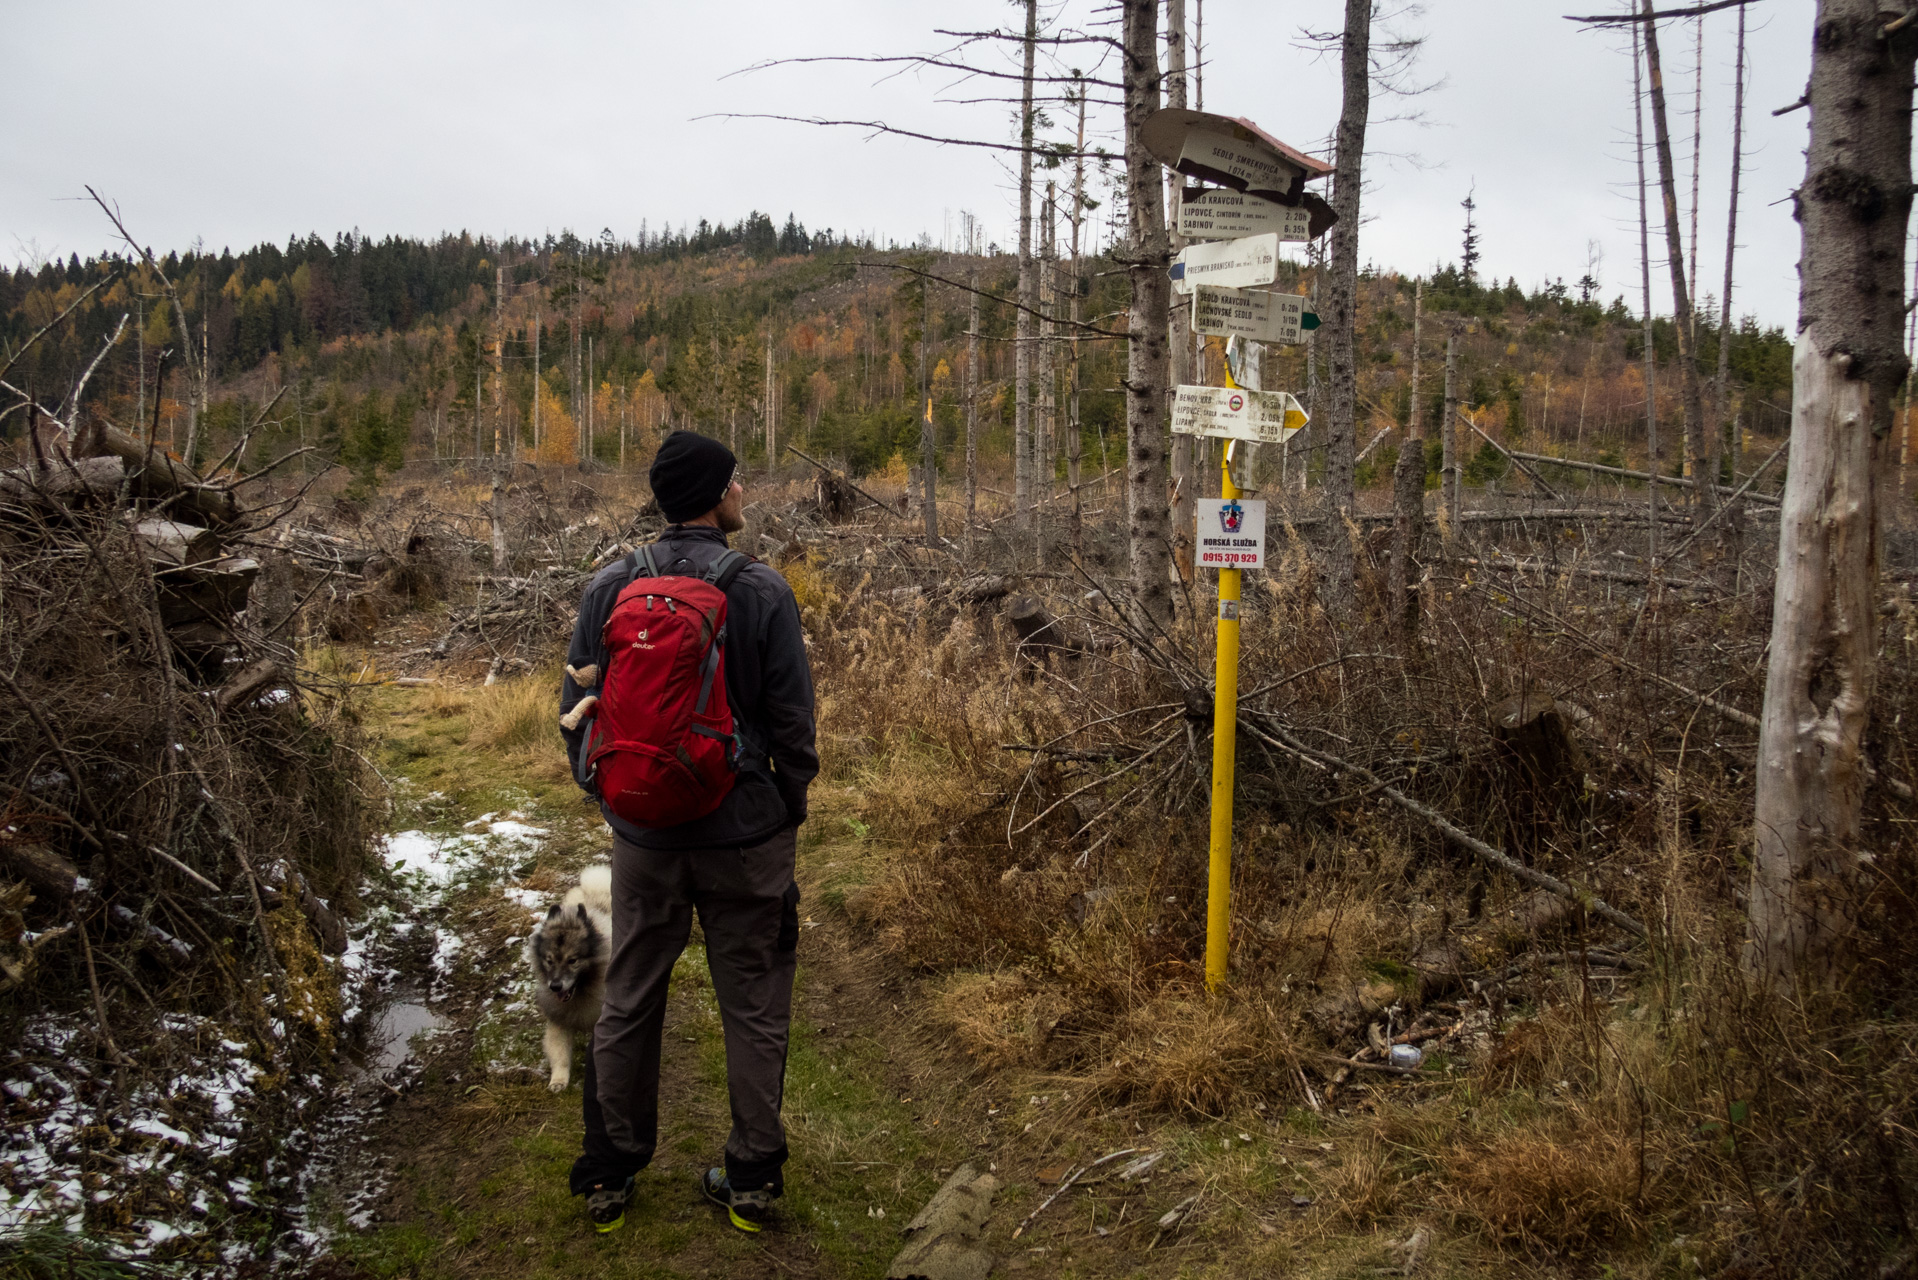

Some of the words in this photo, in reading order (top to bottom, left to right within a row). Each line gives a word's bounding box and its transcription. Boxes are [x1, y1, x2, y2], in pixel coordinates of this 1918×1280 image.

[1212, 147, 1234, 160] SEDLO
[1236, 154, 1279, 175] SMREKOVICA
[1184, 208, 1215, 218] LIPOVCE,
[1183, 220, 1214, 229] SABINOV
[1186, 264, 1209, 274] PRIESMYK
[1210, 261, 1235, 272] BRANISKO
[1200, 292, 1219, 303] SEDLO
[1234, 309, 1253, 320] SEDLO
[1198, 317, 1224, 329] SABINOV
[1203, 537, 1231, 546] HORSKÁ
[1232, 537, 1257, 547] SLUŽBA
[1203, 552, 1223, 563] 0915
[1224, 553, 1240, 563] 370
[1241, 553, 1257, 563] 929
[632, 641, 656, 650] deuter
